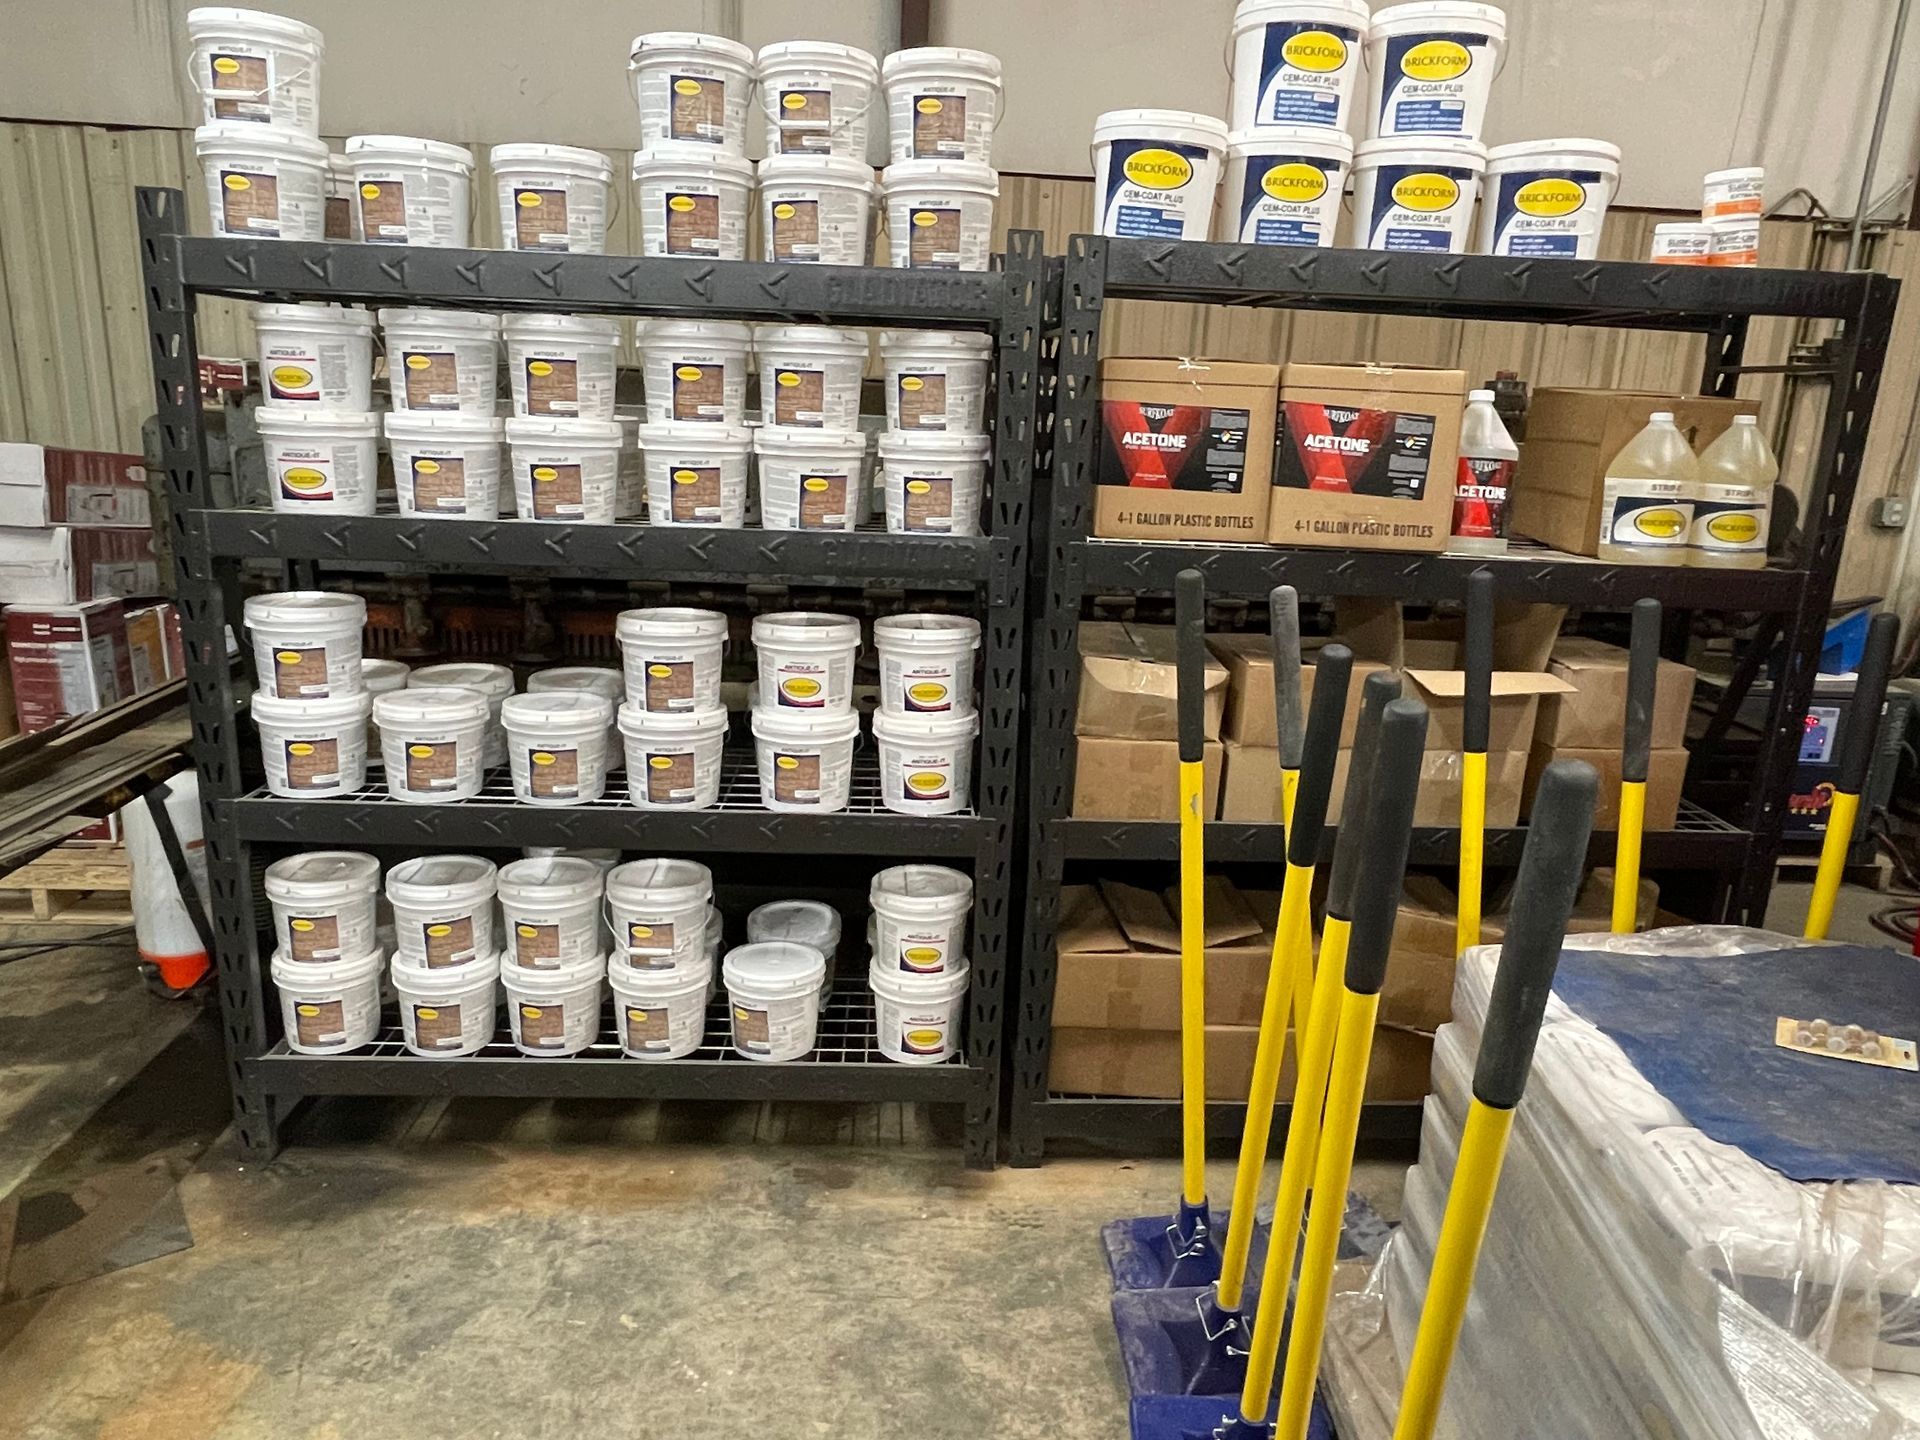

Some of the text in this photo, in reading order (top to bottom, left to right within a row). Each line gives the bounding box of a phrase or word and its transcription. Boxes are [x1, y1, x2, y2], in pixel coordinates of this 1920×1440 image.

[1286, 45, 1344, 59] BRICKFORM
[1404, 56, 1467, 67] BRICKFORM
[1282, 73, 1341, 87] CEM-COAT PLUS
[1402, 83, 1464, 94] CEM-COAT PLUS
[1127, 162, 1188, 177] BRICKFORM
[1265, 177, 1324, 189] BRICKFORM
[1123, 190, 1184, 203] CEM-COAT PLUS
[1396, 187, 1455, 198] BRICKFORM
[1518, 192, 1581, 203] BRICKFORM
[1262, 203, 1321, 215] CEM-COAT PLUS
[1392, 213, 1452, 224] CEM-COAT PLUS
[1515, 219, 1578, 229] CEM-COAT PLUS
[1122, 431, 1187, 449] ACETONE
[1304, 433, 1370, 453] ACETONE
[1118, 512, 1254, 529] 4-1 GALLON PLASTIC BOTTLES
[1295, 520, 1434, 538] 4-1 GALLON PLASTIC BOTTLES
